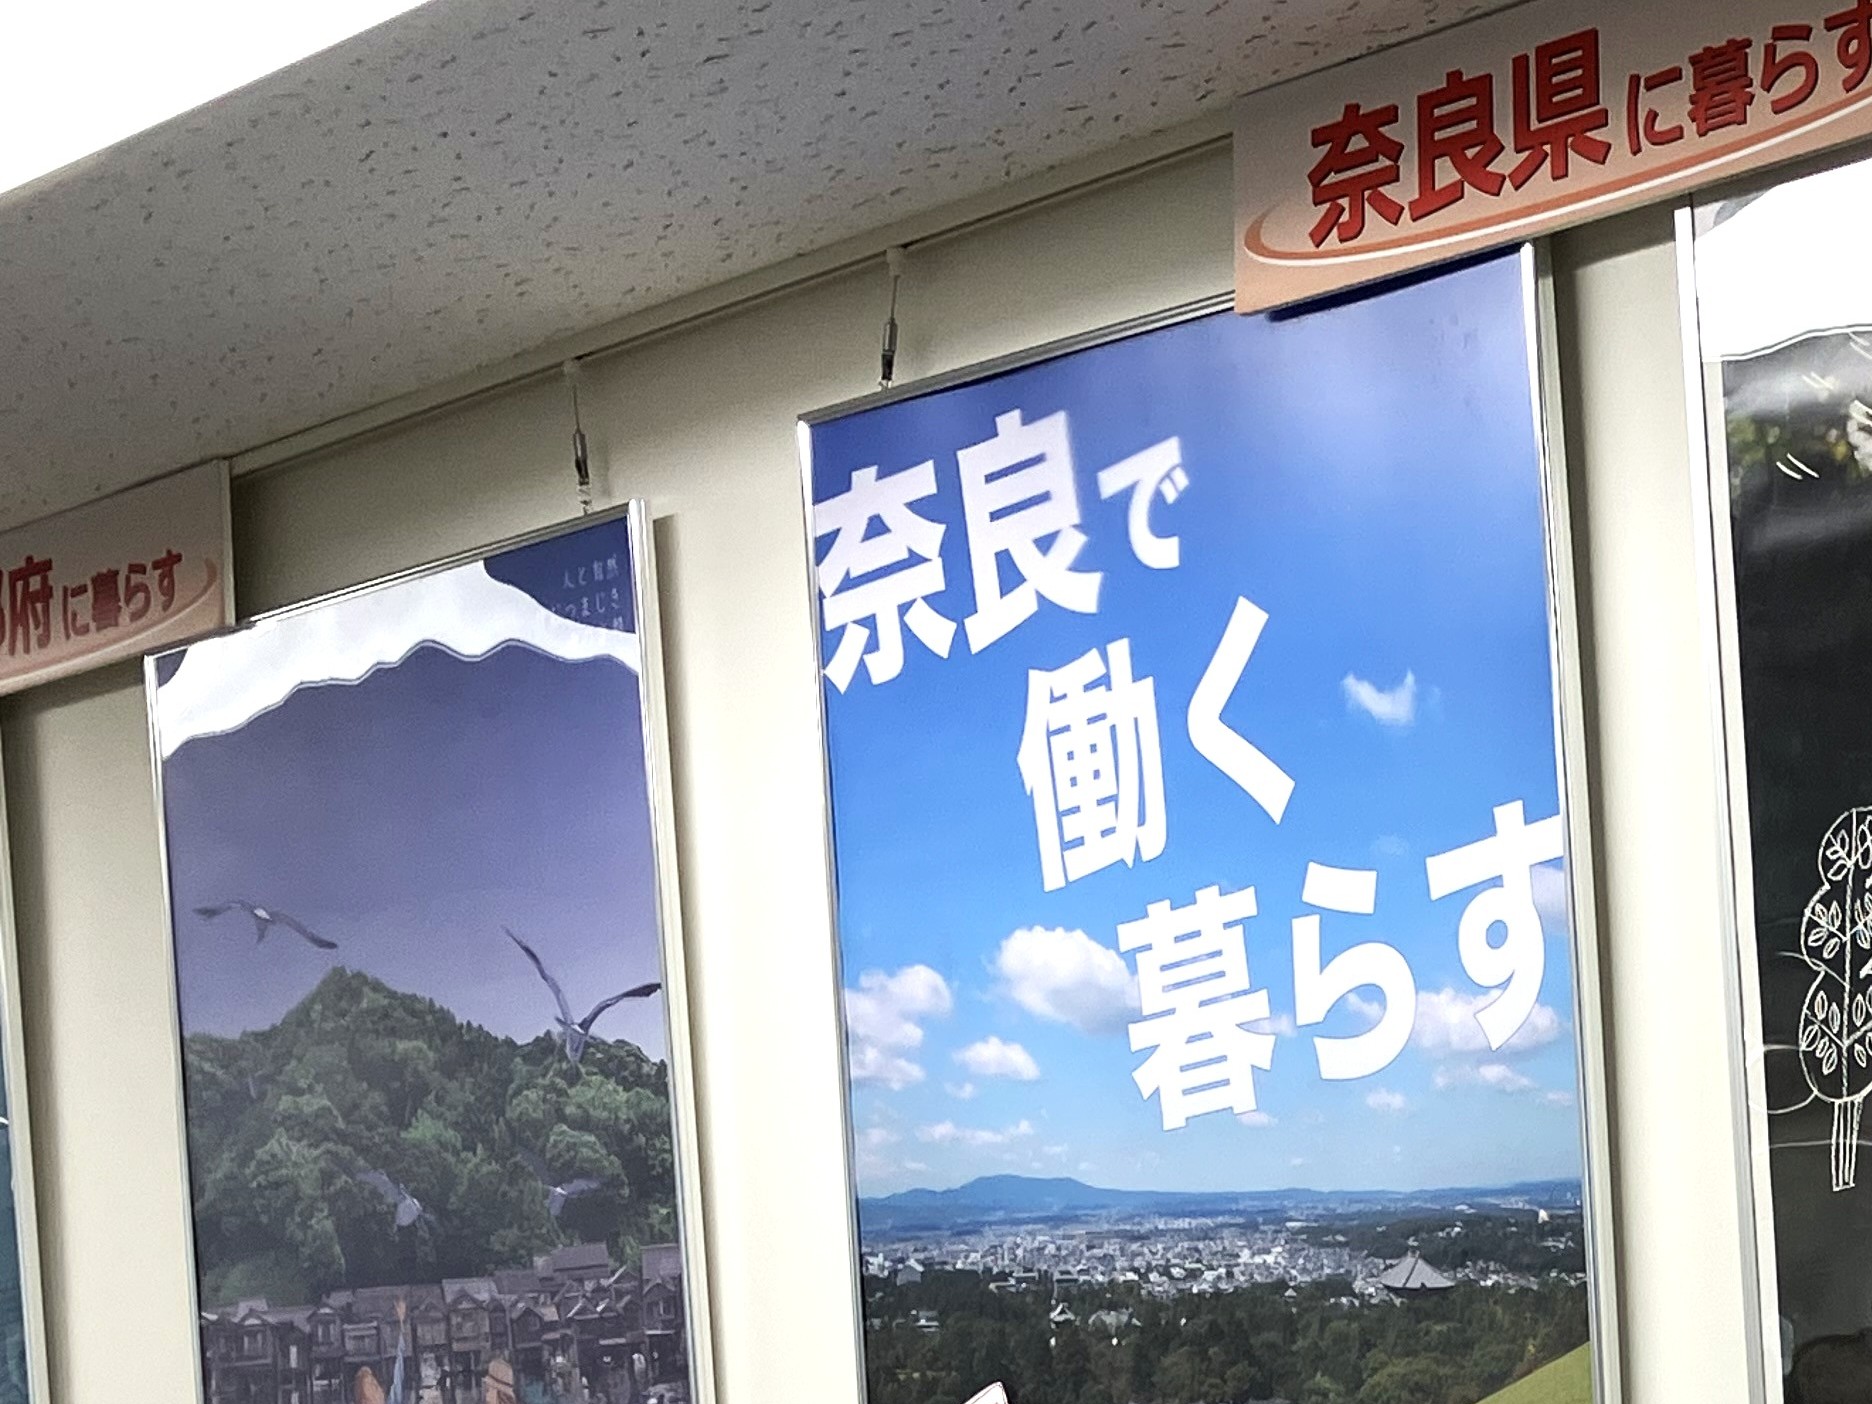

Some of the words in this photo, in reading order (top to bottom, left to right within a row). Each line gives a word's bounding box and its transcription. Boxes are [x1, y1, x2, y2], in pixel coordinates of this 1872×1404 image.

[812, 408, 1190, 694] 奈良で
[1016, 596, 1297, 892] 働く
[1115, 800, 1565, 1132] 暮らす
